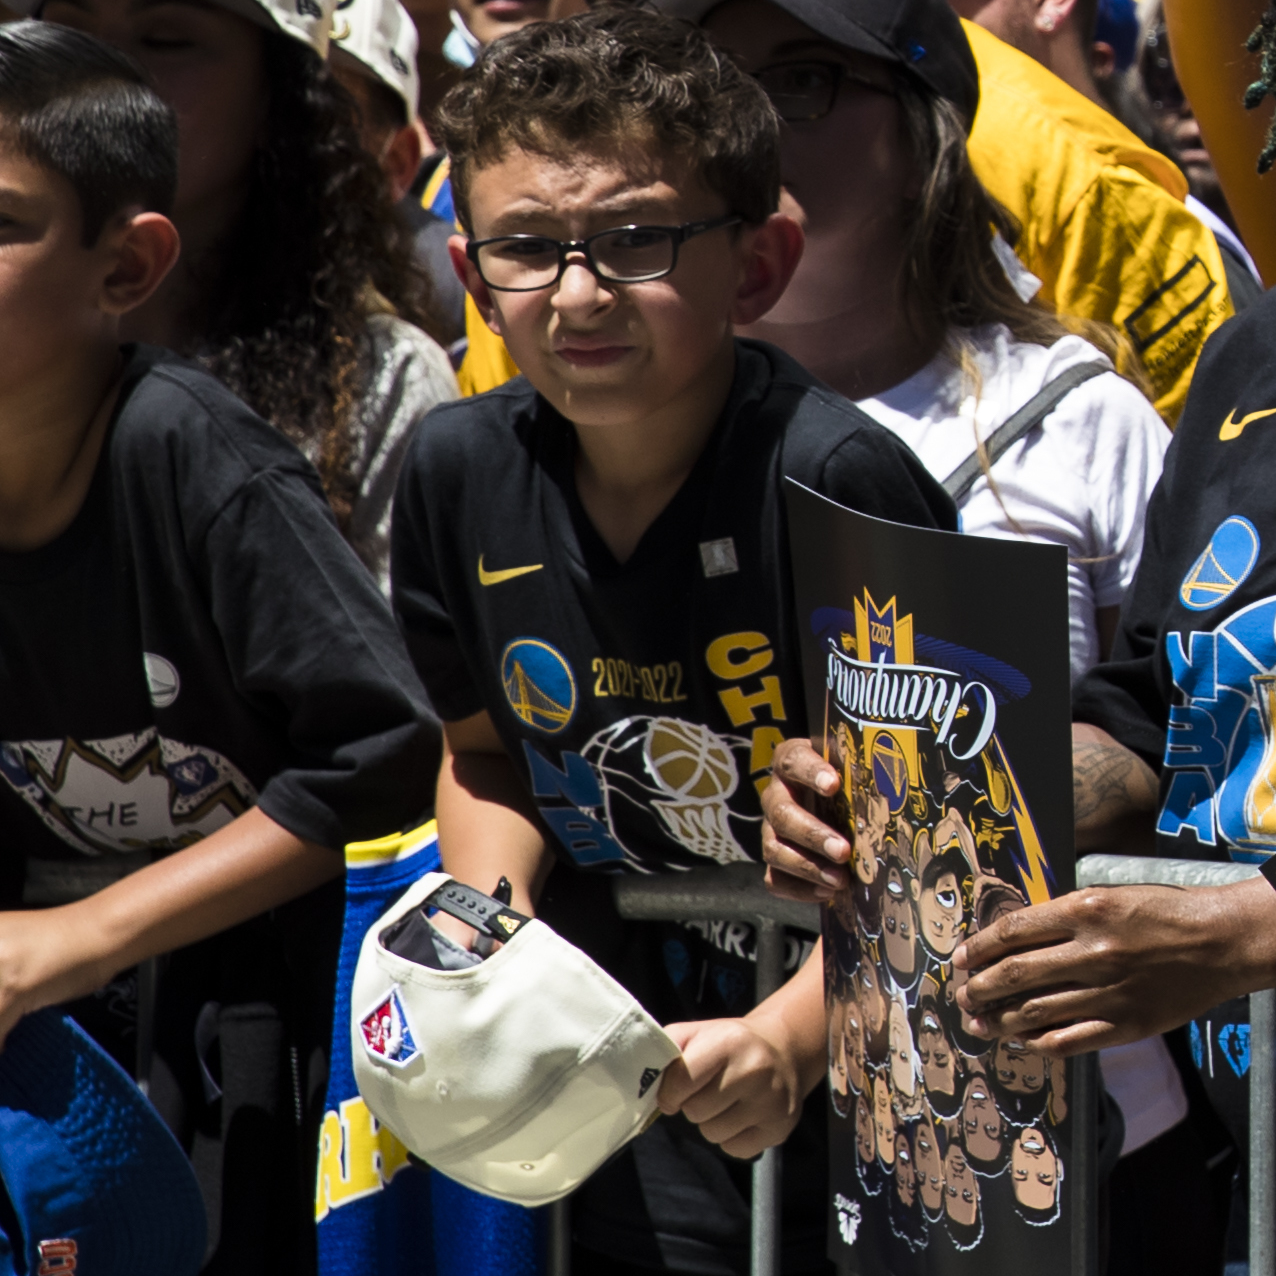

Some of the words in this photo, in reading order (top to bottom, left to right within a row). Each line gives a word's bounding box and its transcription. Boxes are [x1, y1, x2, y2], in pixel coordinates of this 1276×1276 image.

[870, 620, 893, 648] 2022
[591, 657, 688, 703] 2021-022
[826, 647, 997, 761] Champions
[522, 738, 626, 866] NB
